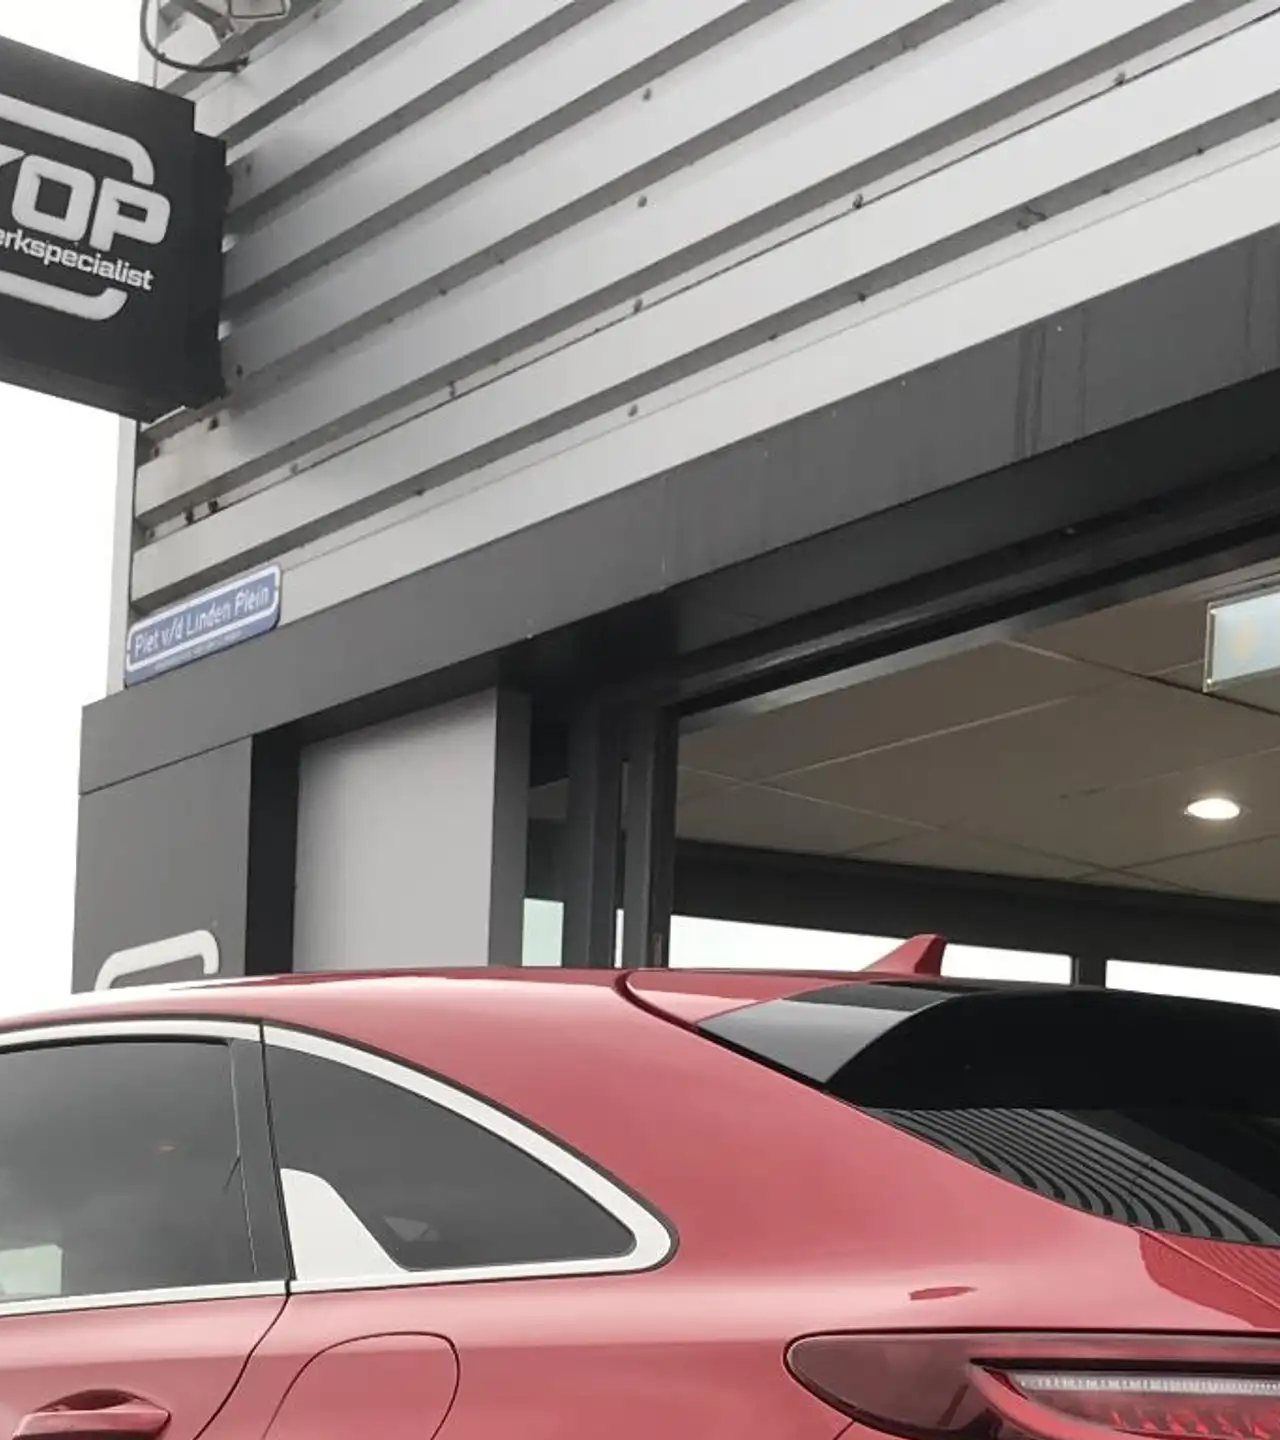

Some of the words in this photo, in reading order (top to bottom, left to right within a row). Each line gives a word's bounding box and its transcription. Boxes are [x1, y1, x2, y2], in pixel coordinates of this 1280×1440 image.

[134, 630, 159, 658] Piet
[161, 616, 183, 643] v/d
[186, 601, 231, 636] Linden
[234, 586, 269, 616] Plein
